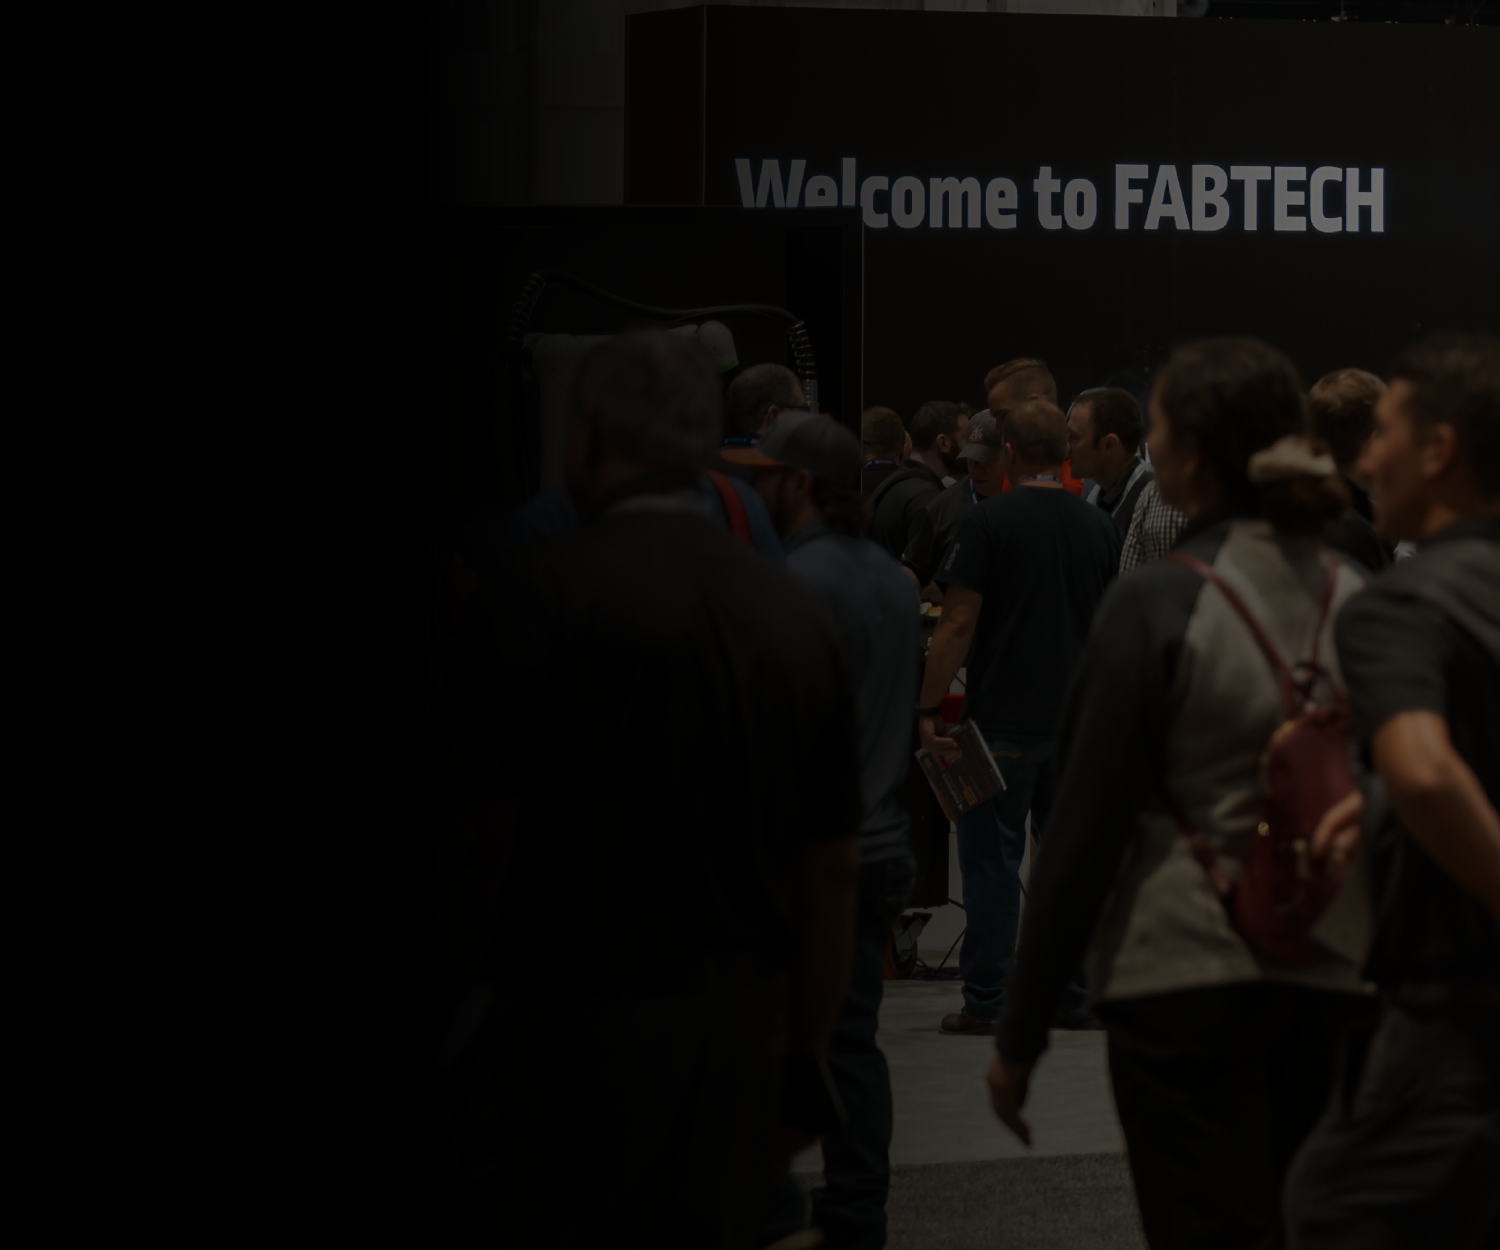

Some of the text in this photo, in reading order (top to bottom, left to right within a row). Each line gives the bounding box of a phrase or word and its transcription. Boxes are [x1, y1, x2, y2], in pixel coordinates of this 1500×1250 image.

[736, 156, 1385, 234] Welcome to FABTECH
